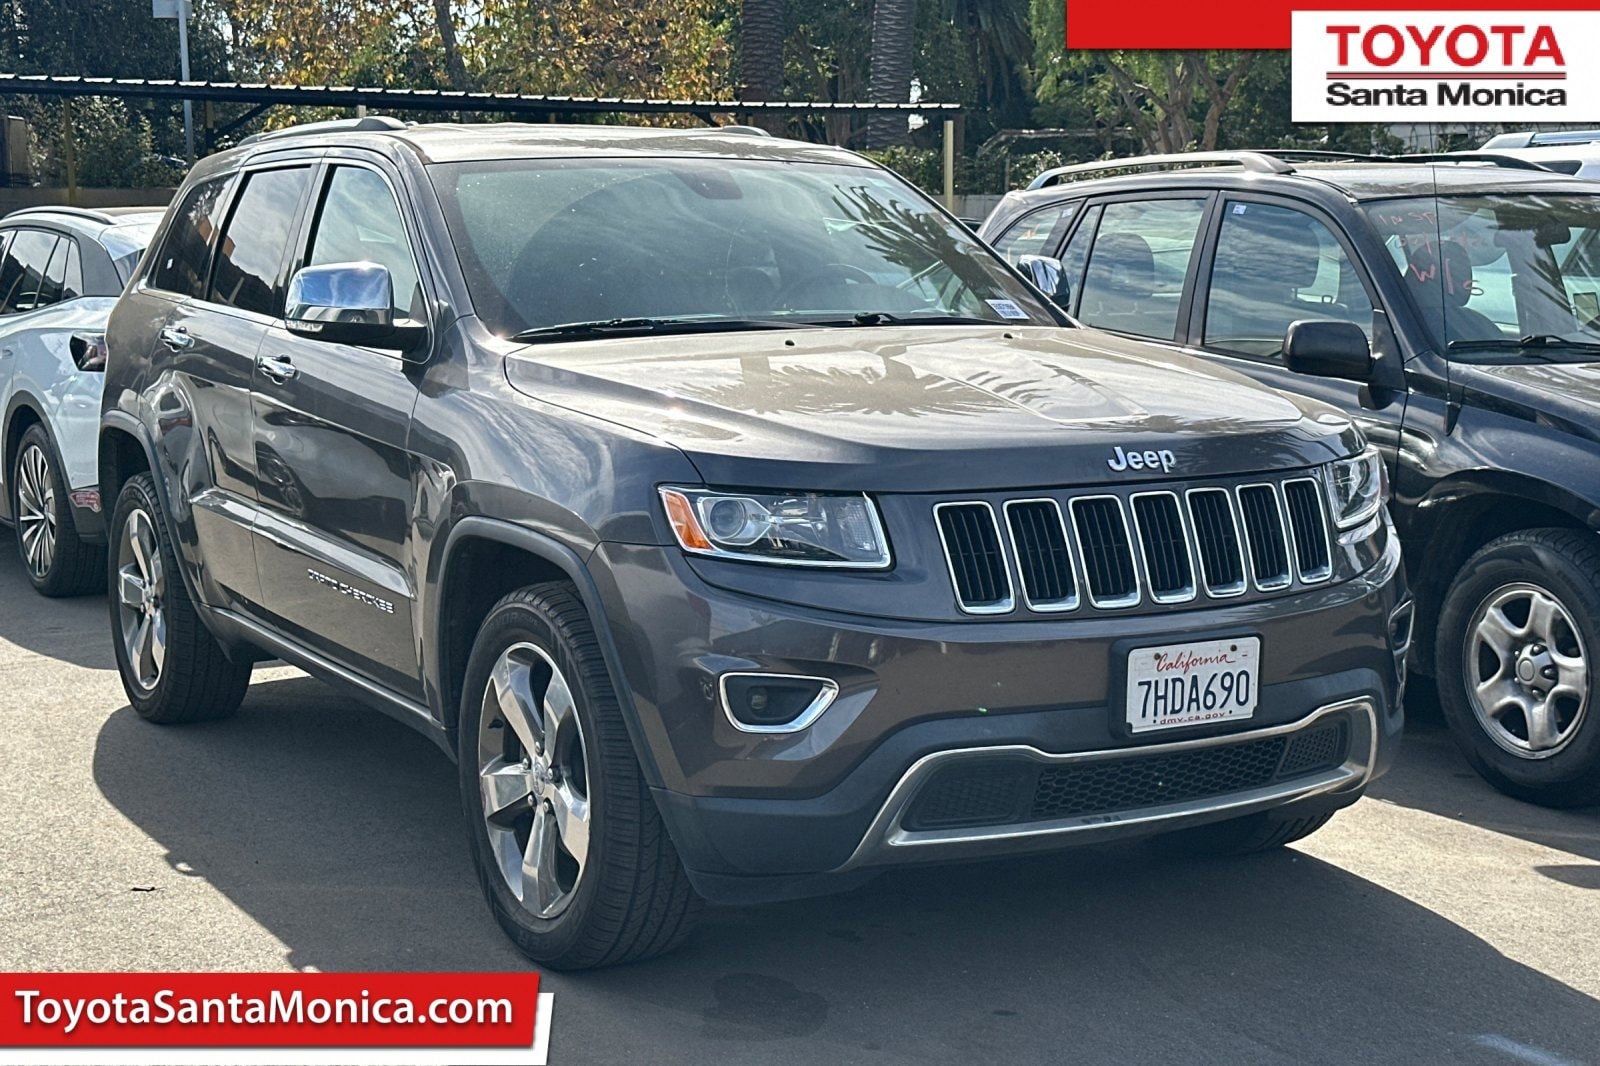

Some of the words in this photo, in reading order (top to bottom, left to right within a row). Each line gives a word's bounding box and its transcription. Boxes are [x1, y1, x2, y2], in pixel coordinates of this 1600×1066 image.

[1107, 446, 1176, 473] Jeep
[1156, 651, 1235, 674] California
[1138, 670, 1250, 718] 7HDA690
[1160, 711, 1226, 725] dmv.ca.gov
